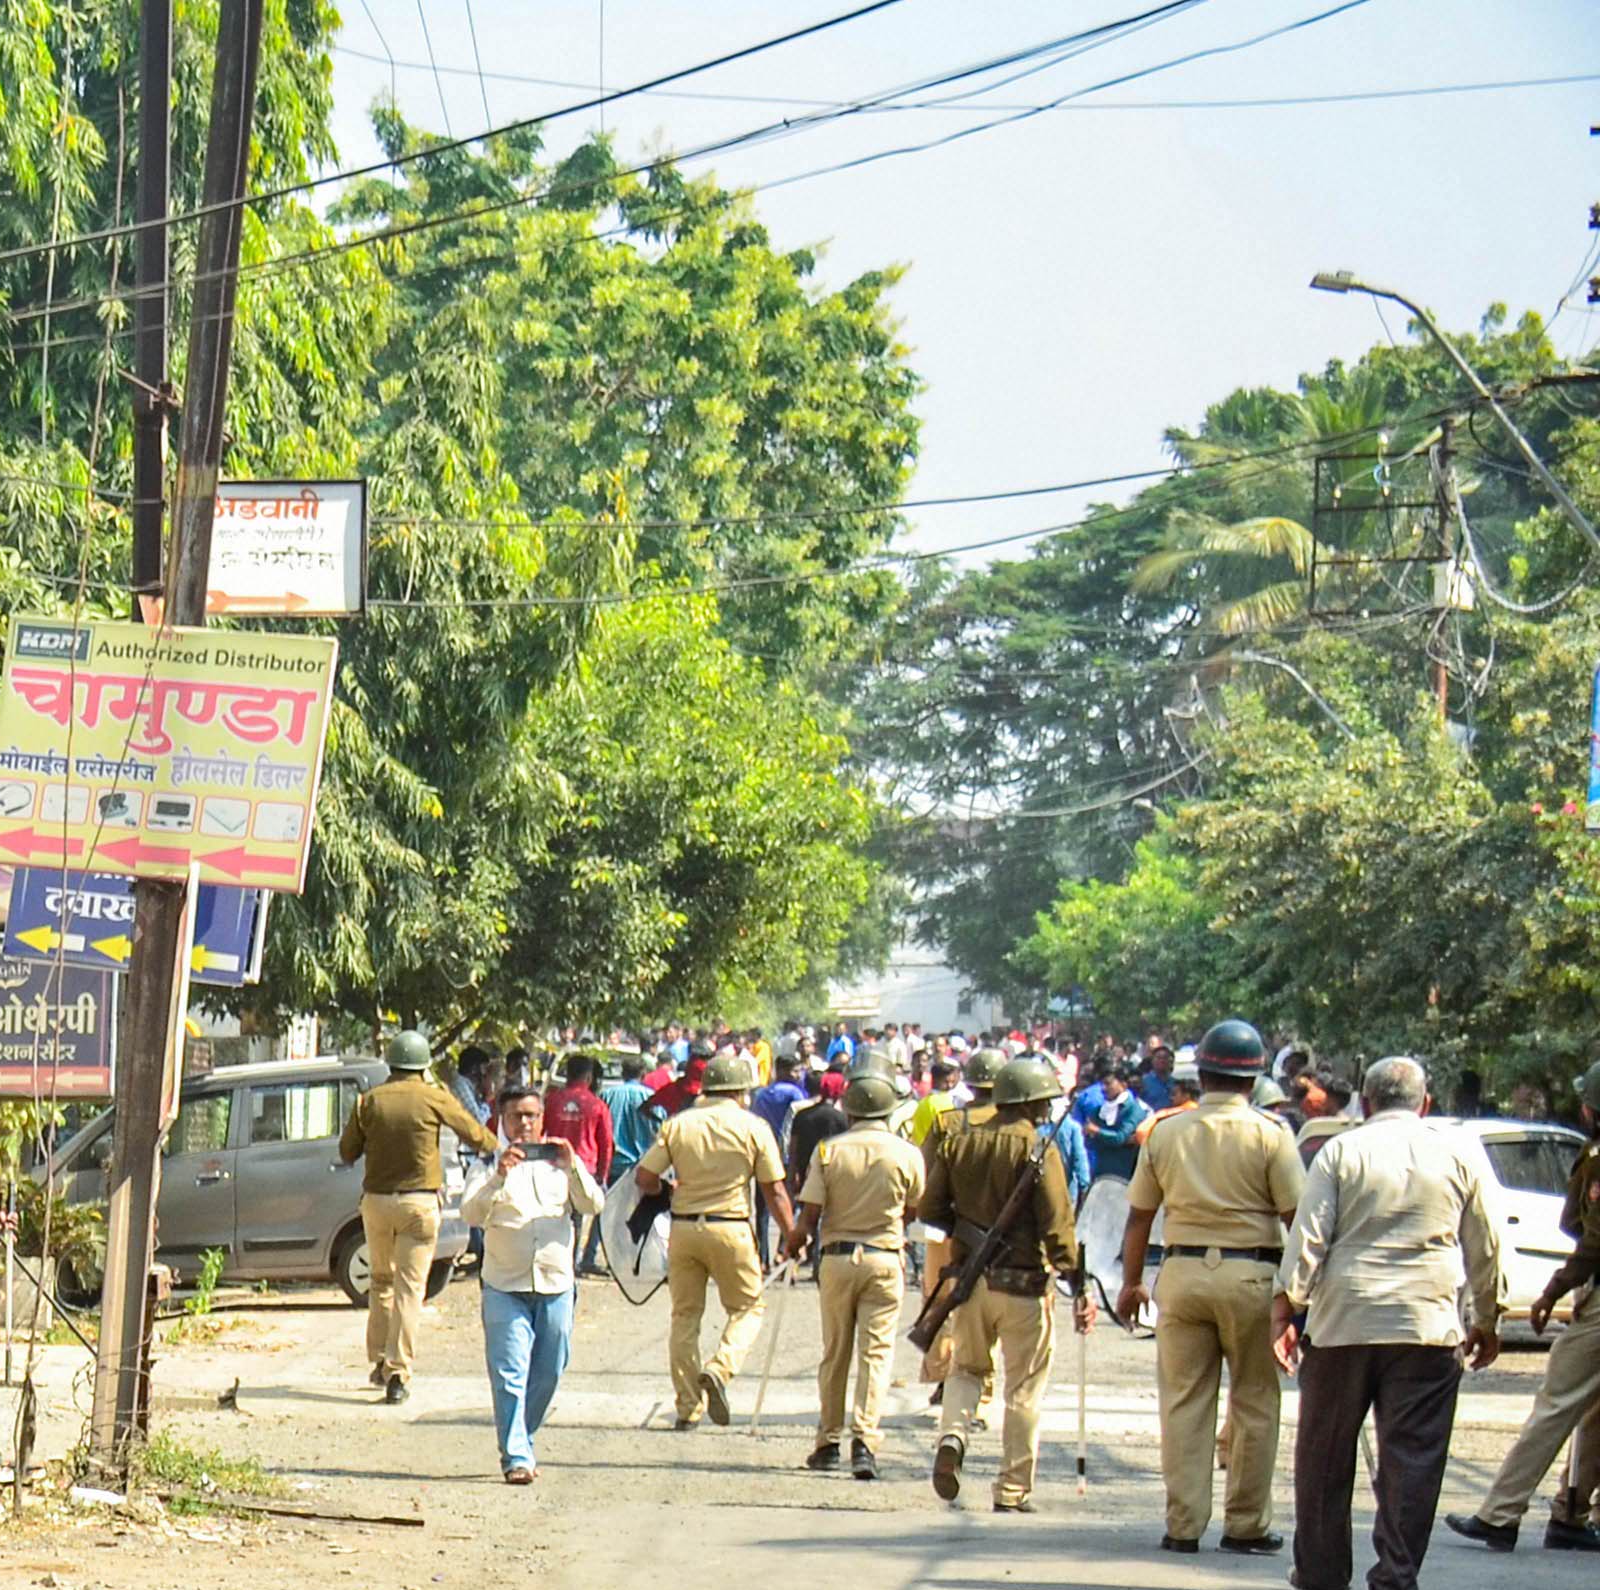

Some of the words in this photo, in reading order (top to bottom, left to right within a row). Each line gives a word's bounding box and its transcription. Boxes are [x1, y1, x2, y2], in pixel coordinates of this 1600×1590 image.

[20, 631, 82, 651] KDM
[96, 640, 208, 665] Authorized
[214, 648, 327, 674] Distributor
[11, 667, 318, 756] चामुण्डा
[170, 746, 248, 787] होलसेल
[253, 752, 308, 790] डिलर
[45, 885, 137, 922] दवाख
